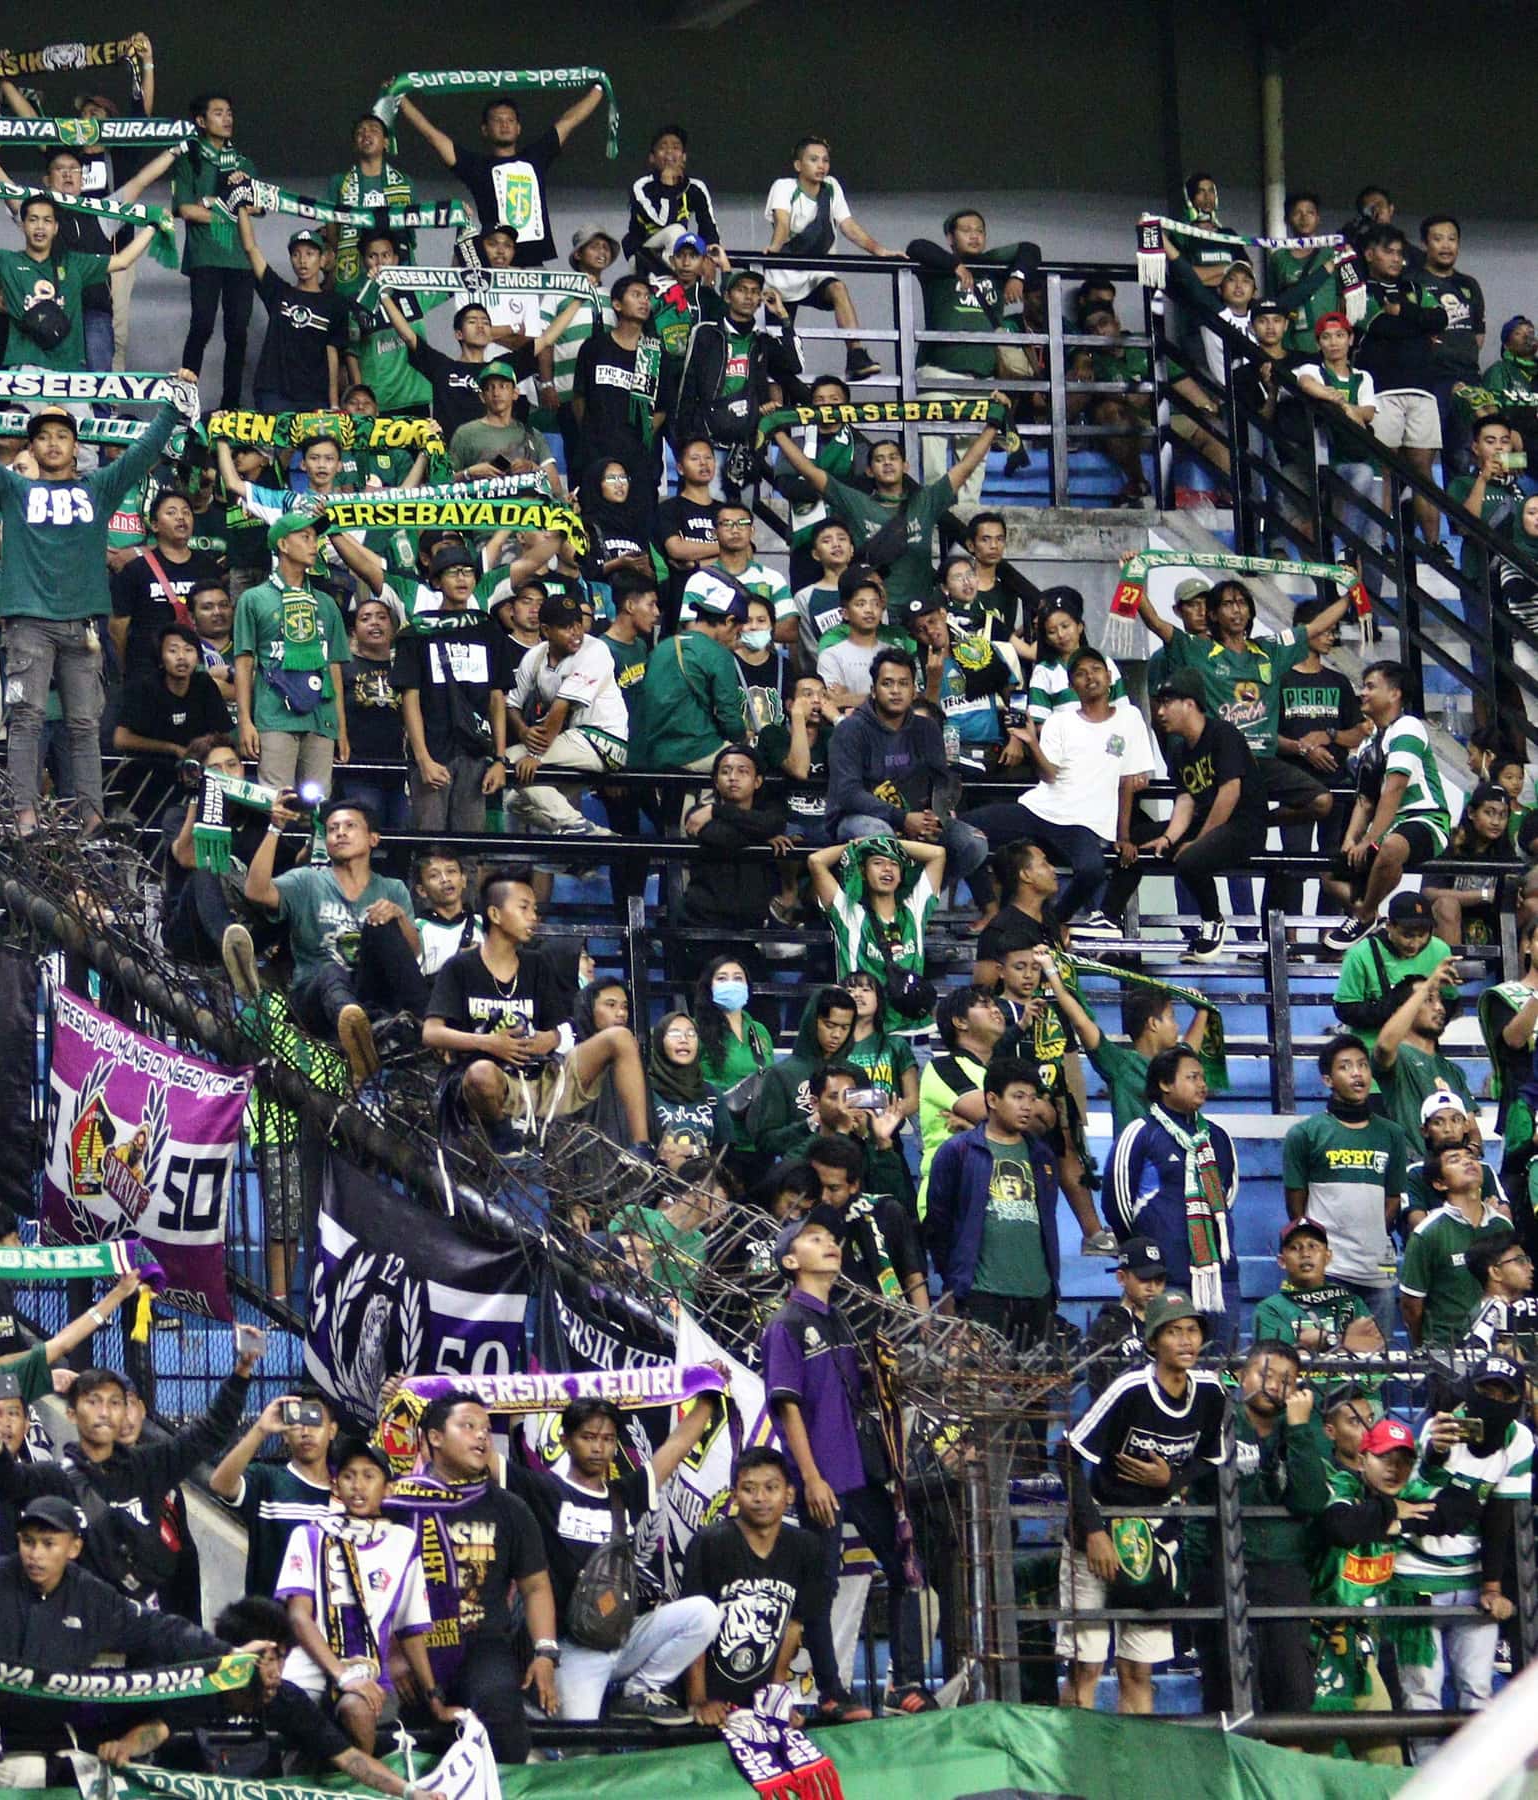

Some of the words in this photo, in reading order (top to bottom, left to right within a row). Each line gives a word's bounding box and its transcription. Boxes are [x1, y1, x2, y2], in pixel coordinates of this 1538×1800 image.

[408, 69, 517, 89] Surabaya
[390, 208, 464, 228] MANIA
[378, 270, 460, 286] PERSEBAYA
[497, 273, 542, 288] EMOSI
[797, 400, 990, 426] PERSEBAYA
[379, 1252, 406, 1288] 12
[1485, 1357, 1517, 1377] 1927
[578, 1367, 684, 1398] KEDIRI
[42, 1666, 206, 1698] SURABAYA
